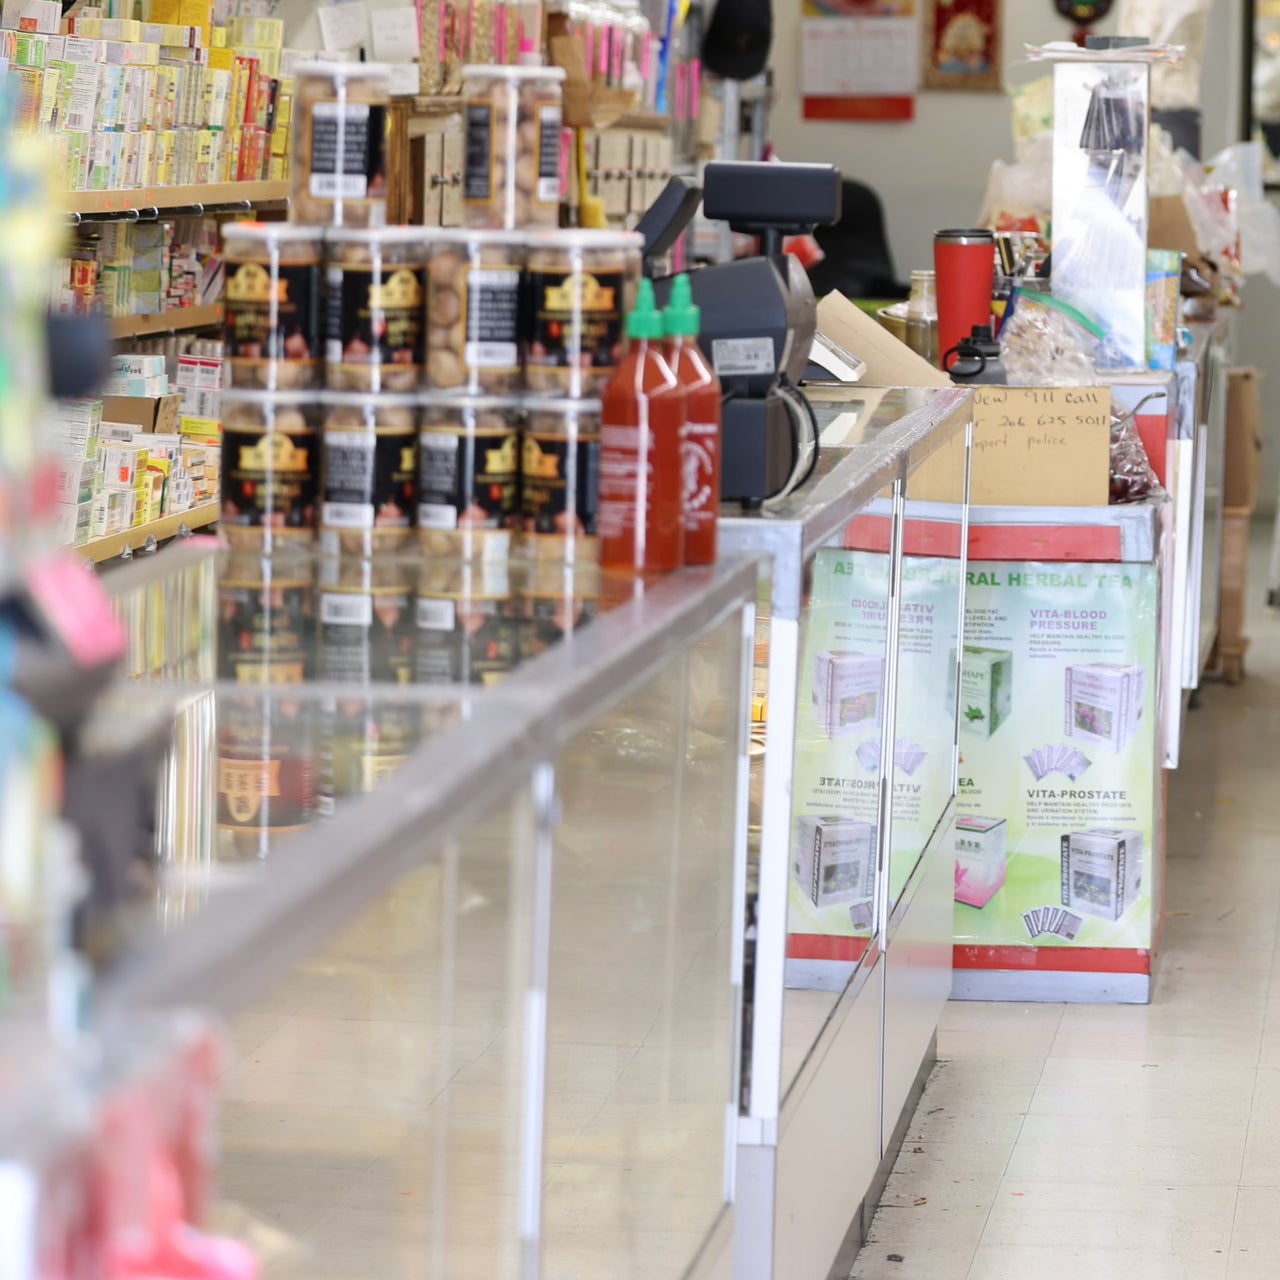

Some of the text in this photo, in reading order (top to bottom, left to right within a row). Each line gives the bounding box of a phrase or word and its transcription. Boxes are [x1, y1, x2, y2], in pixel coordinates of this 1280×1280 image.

[1024, 390, 1054, 404] 911
[997, 415, 1026, 427] 206
[1037, 415, 1066, 426] 625
[1075, 415, 1107, 426] 5011
[974, 434, 1069, 453] eport police
[965, 572, 1133, 589] RAL HERBAL TEA
[1030, 608, 1107, 620] VITA-BLOOD
[1029, 620, 1098, 631] PRESSURE
[958, 777, 975, 787] EA
[1027, 789, 1127, 800] VITA-PROSTATE
